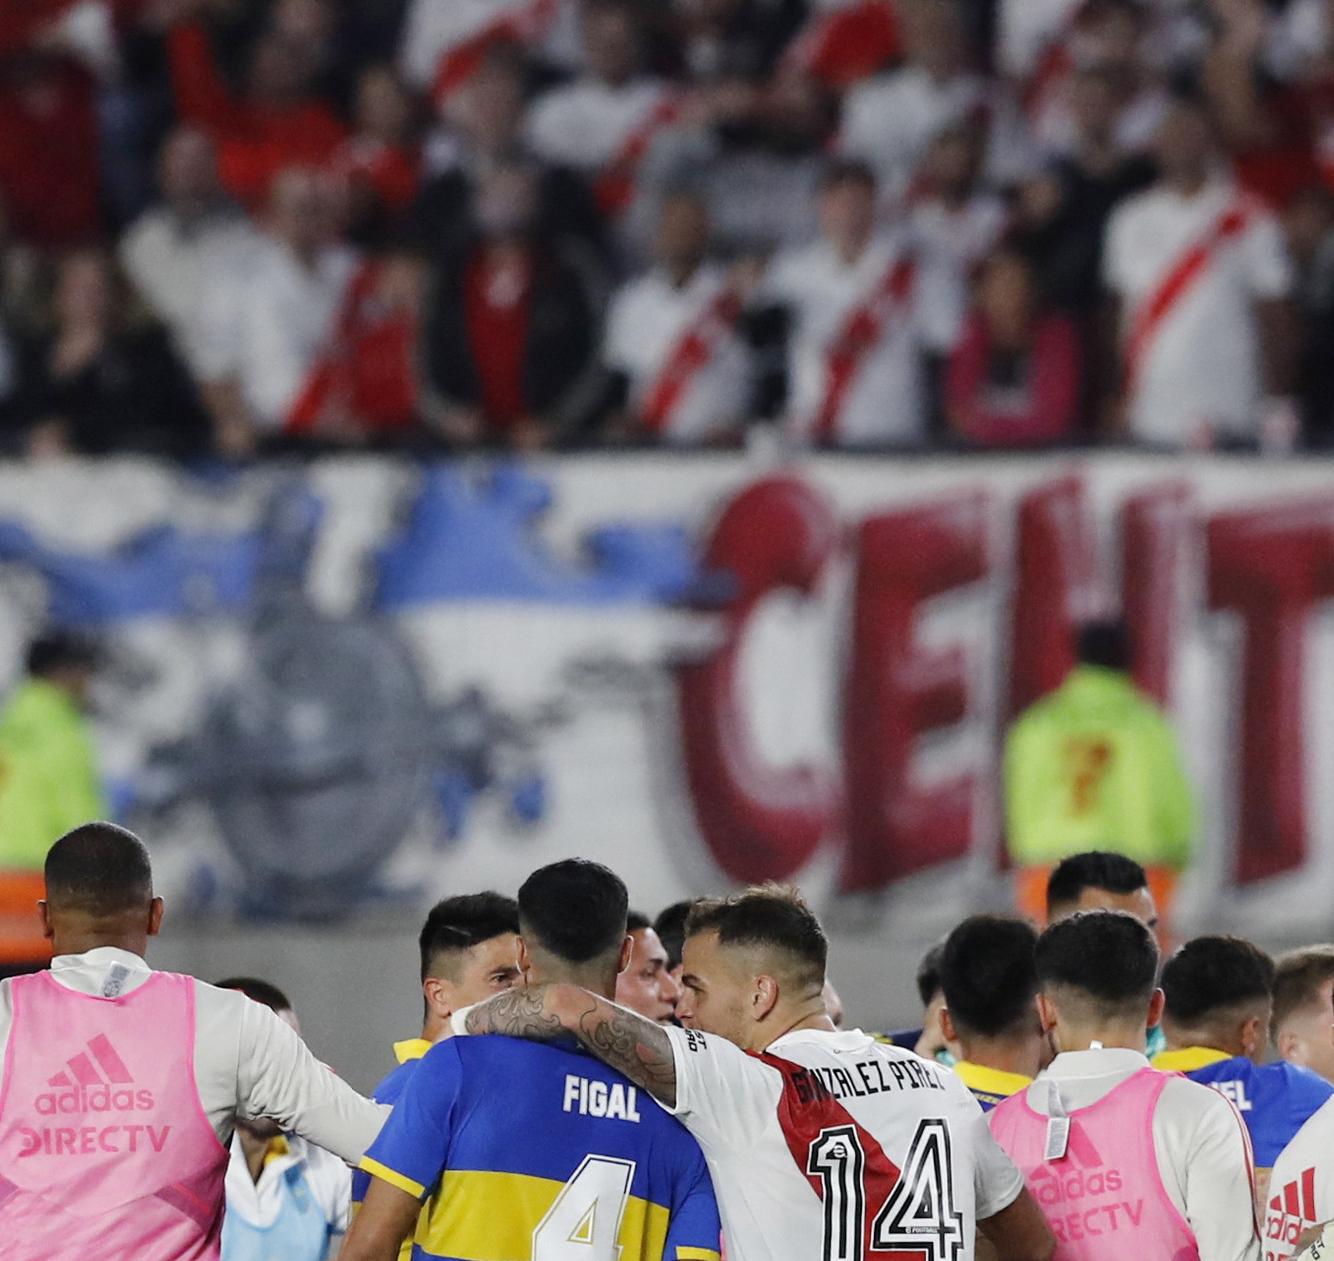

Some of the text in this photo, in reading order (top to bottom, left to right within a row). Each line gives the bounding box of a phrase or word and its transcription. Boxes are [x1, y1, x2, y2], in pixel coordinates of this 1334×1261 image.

[34, 1084, 155, 1115] adidas
[563, 1073, 640, 1123] FIGAL
[18, 1125, 171, 1158] DIRECTV
[1047, 1199, 1144, 1243] RECTV
